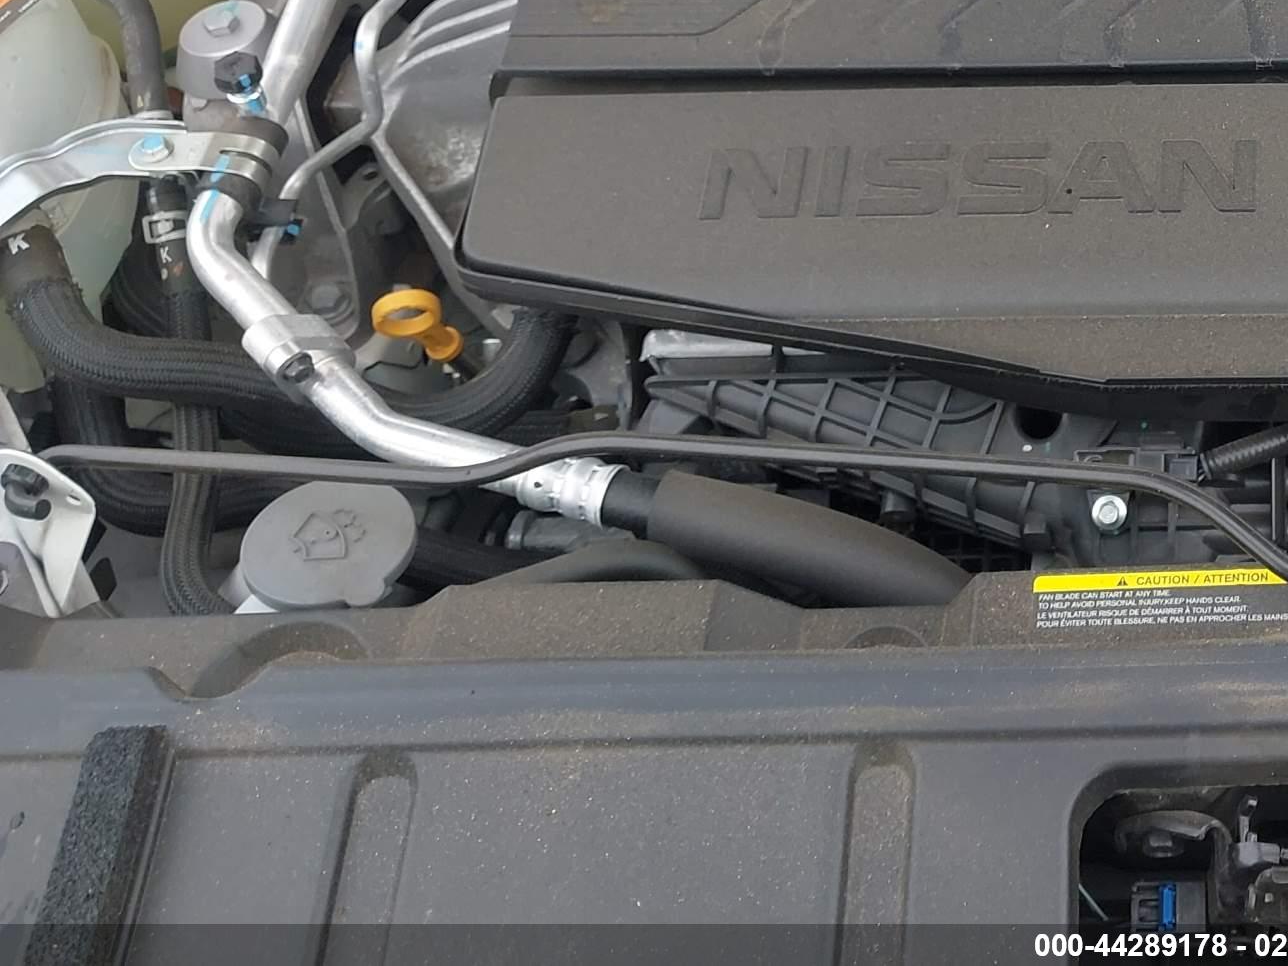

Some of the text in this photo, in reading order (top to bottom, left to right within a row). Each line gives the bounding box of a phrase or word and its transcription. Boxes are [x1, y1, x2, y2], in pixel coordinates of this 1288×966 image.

[698, 138, 1258, 220] NISSAN
[8, 233, 30, 255] K
[160, 246, 172, 263] K
[1136, 572, 1269, 586] CAUTION / ATTENTION
[1055, 592, 1080, 601] BLADE
[1081, 591, 1098, 600] CAN
[1100, 590, 1122, 599] START
[1124, 590, 1134, 598] AT
[1136, 589, 1151, 597] ANY
[1039, 601, 1049, 610] TO
[1050, 600, 1070, 609] HELP
[1071, 600, 1095, 608] AVOID
[1096, 599, 1137, 607] PERSONAL
[1186, 596, 1213, 604] HANDS
[1036, 620, 1059, 628] POUR
[1060, 618, 1086, 627] ÉVITER
[1088, 618, 1113, 626] TOUTE
[1157, 616, 1168, 624] NE
[1169, 615, 1185, 624] PAS
[1186, 614, 1197, 623] EN
[1198, 613, 1247, 622] APPROCHER
[1248, 613, 1263, 622] LES
[1264, 612, 1288, 621] MAINS
[1037, 612, 1047, 620] LE
[1048, 610, 1098, 619] VENTILATEUR
[1099, 608, 1128, 617] RISQUE
[1129, 608, 1139, 616] DE
[1140, 606, 1184, 615] DÉMARRER
[1192, 606, 1212, 614] TOUT
